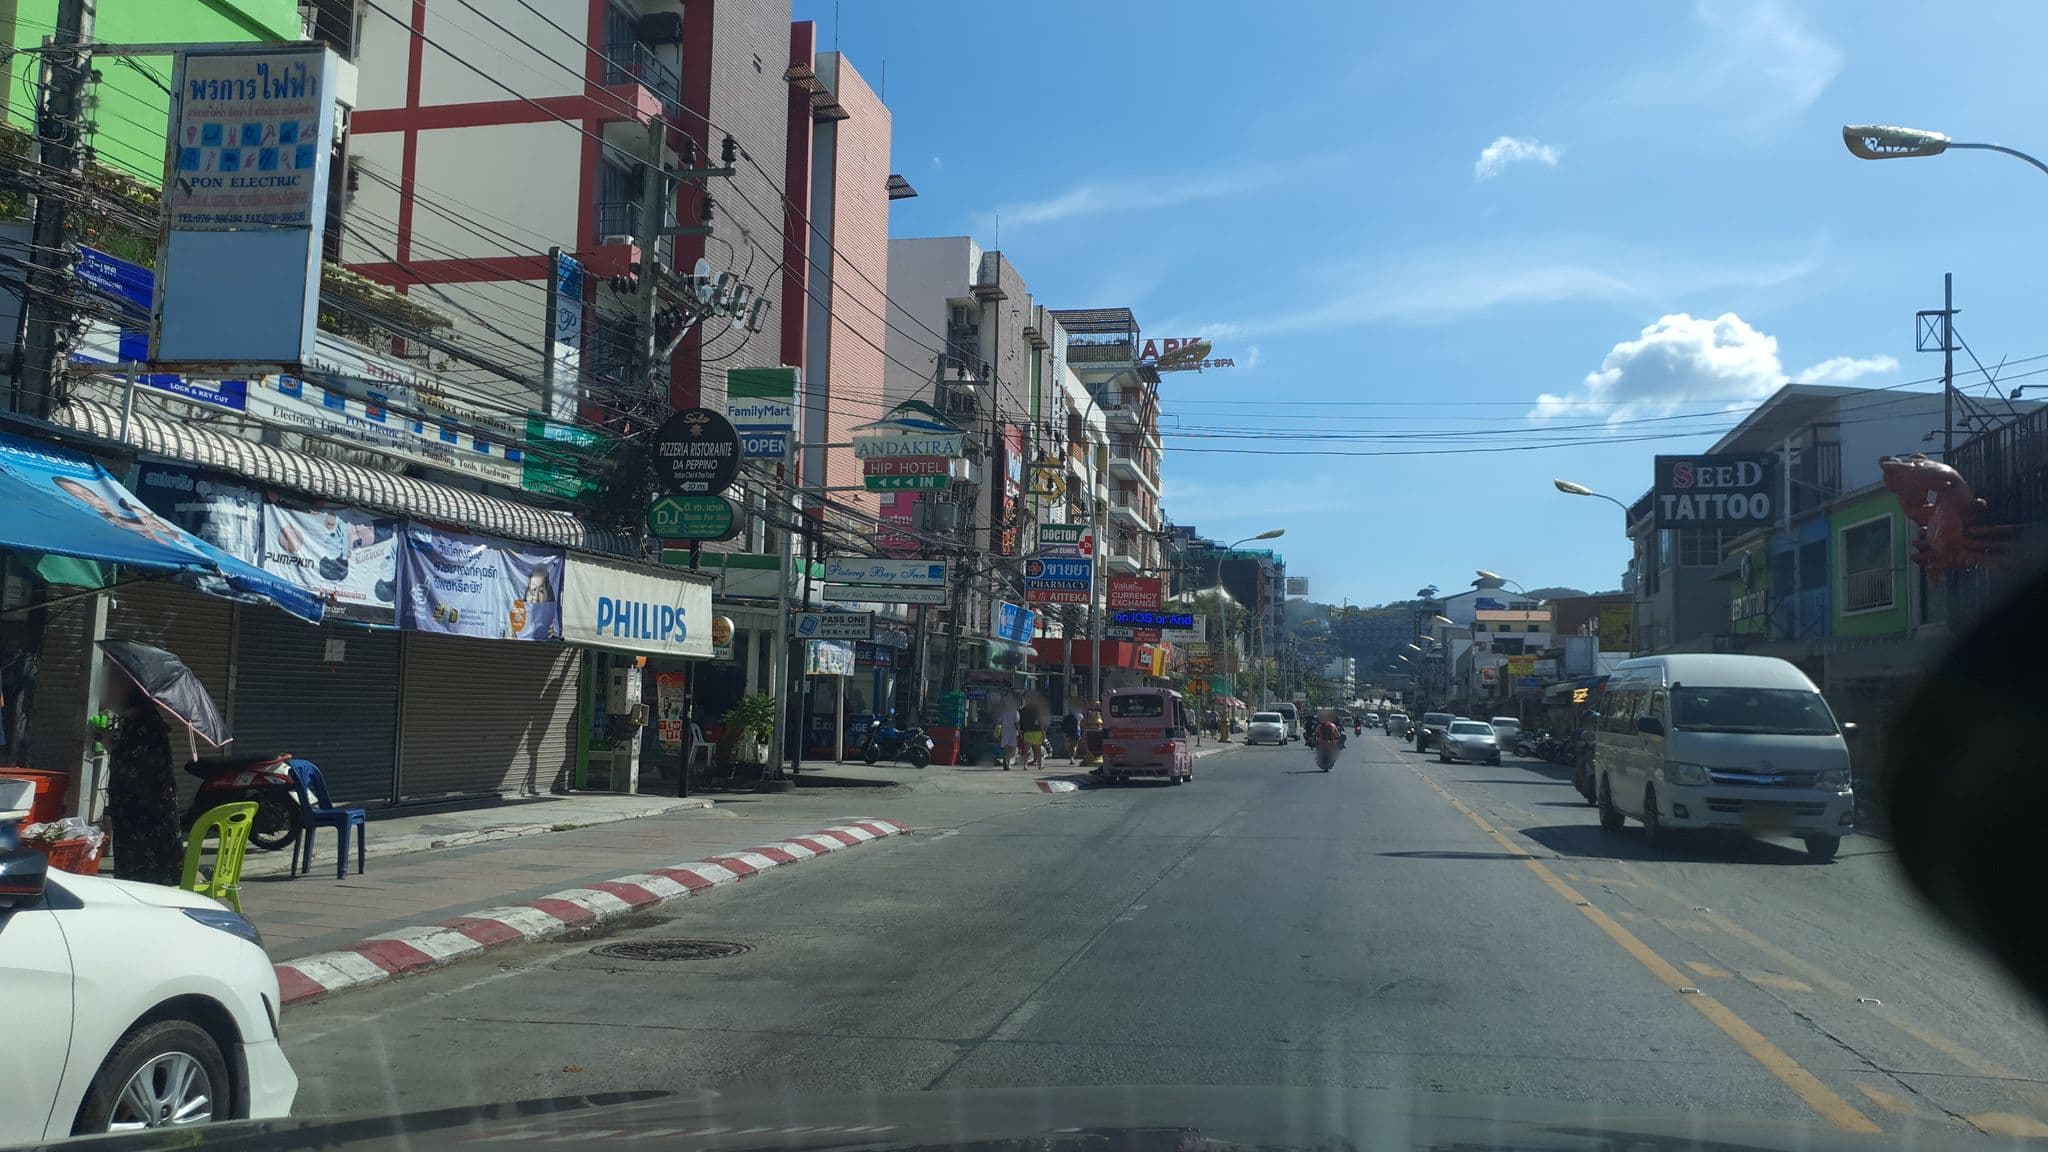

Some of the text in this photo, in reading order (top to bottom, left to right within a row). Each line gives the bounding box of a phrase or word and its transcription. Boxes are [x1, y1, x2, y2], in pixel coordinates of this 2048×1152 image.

[190, 61, 316, 100] พรการไฟฟ้า
[191, 174, 301, 188] PON ELECTRIC
[170, 382, 189, 395] LOCK
[198, 390, 213, 399] KEY
[214, 394, 229, 403] CUT
[728, 405, 792, 419] FamilyMart
[272, 406, 317, 428] Electrical,
[321, 418, 357, 440] Lighting,
[360, 431, 381, 446] Fans,
[480, 465, 511, 481] Hardware
[659, 442, 733, 457] PIZZERIA RISTORANTE
[748, 439, 787, 453] OPEN
[860, 440, 954, 455] ANDAKIRA
[672, 459, 718, 470] DA PEPPINO
[871, 462, 943, 474] HIP HOTEL
[919, 477, 935, 487] IN
[1659, 492, 1771, 521] TATTOO
[657, 510, 679, 526] DJ
[1042, 529, 1078, 541] DOCTOR
[263, 551, 315, 570] PUMPKIN
[826, 563, 927, 582] Patong Bay Inn
[1047, 563, 1090, 577] ขายยา
[1031, 580, 1086, 589] PHARMACY
[1049, 592, 1088, 601] АПТЕКА
[1111, 592, 1158, 600] CURRENCY
[1111, 600, 1157, 608] EXCHANGE
[596, 596, 687, 643] PHILIPS
[821, 615, 867, 623] PASS ONE
[1155, 616, 1165, 624] or
[1112, 629, 1129, 637] ATM
